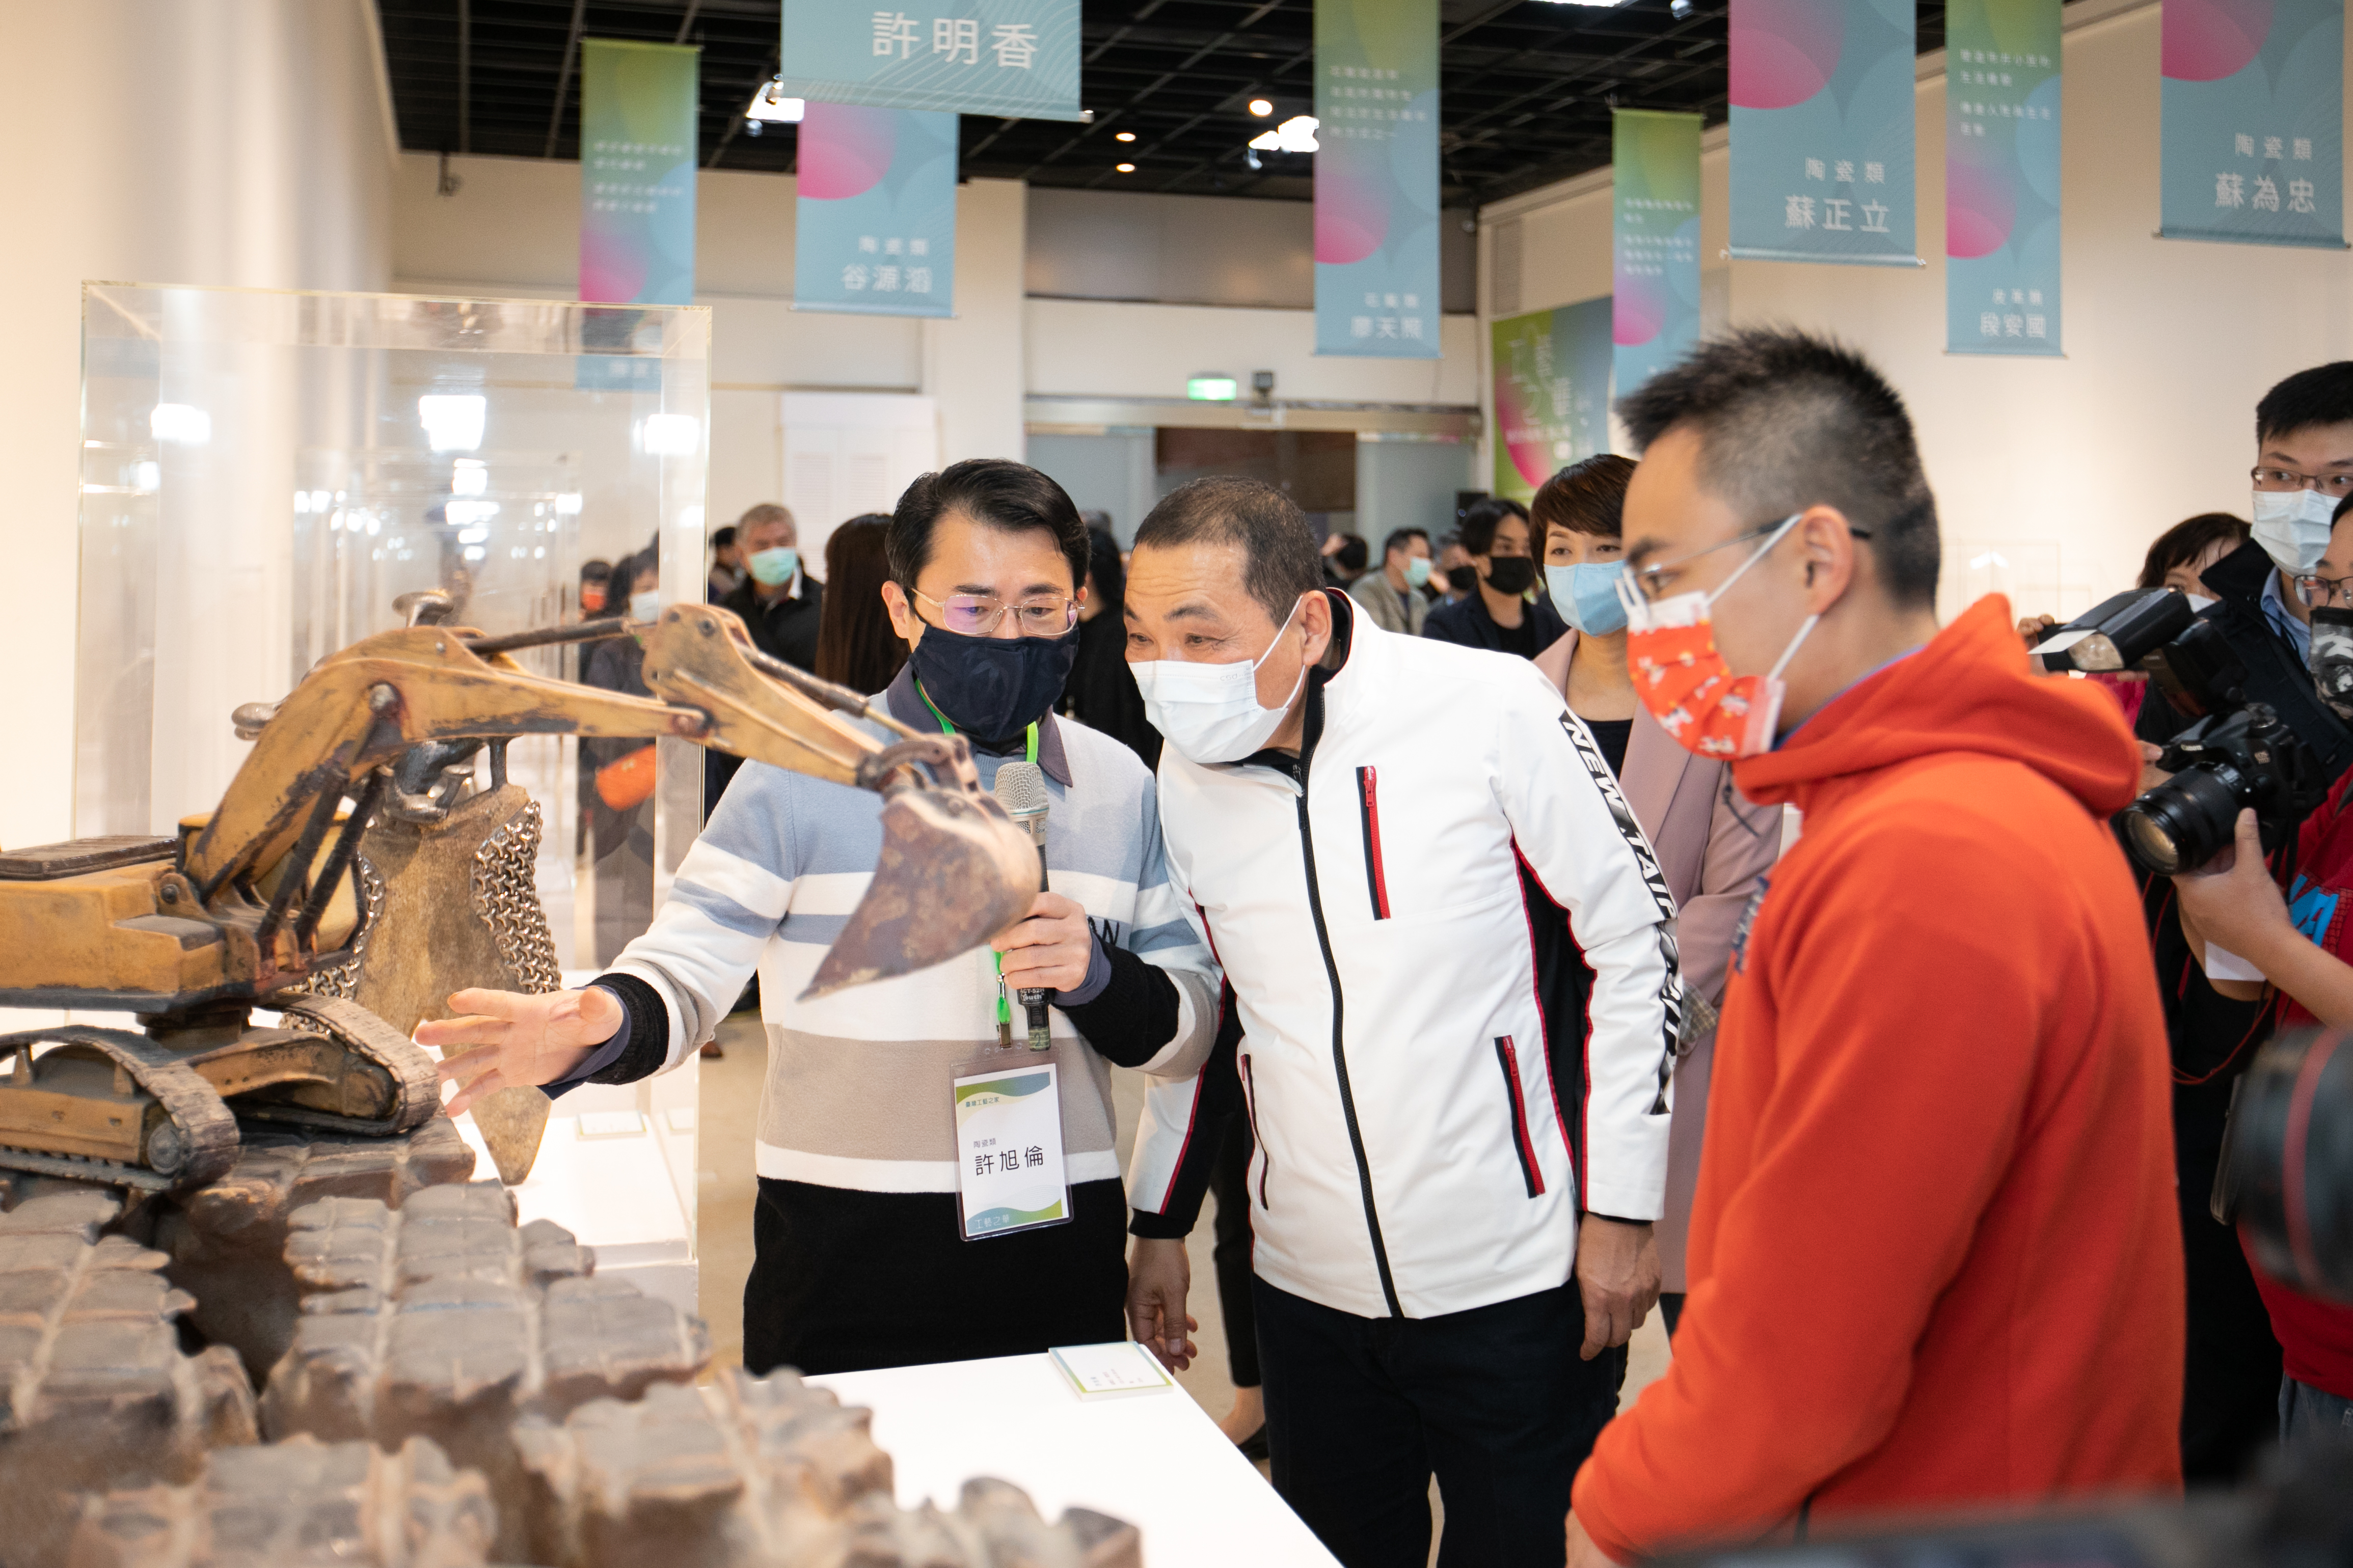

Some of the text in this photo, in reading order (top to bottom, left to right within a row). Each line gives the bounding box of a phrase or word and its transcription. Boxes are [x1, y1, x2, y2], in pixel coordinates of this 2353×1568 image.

[871, 11, 1039, 70] 許明香
[2234, 132, 2313, 162] 陶瓷類
[1805, 156, 1886, 184] 陶瓷類
[2215, 172, 2316, 213] 蘇為忠
[1784, 194, 1890, 233] 蘇正立
[1561, 721, 1627, 812] NEW
[1020, 993, 1042, 1001] Youth
[965, 1097, 999, 1108] 臺灣工藝之家
[973, 1138, 996, 1149] 陶瓷類
[975, 1146, 1044, 1176] 許旭倫
[975, 1214, 1010, 1230] 工藝之華
